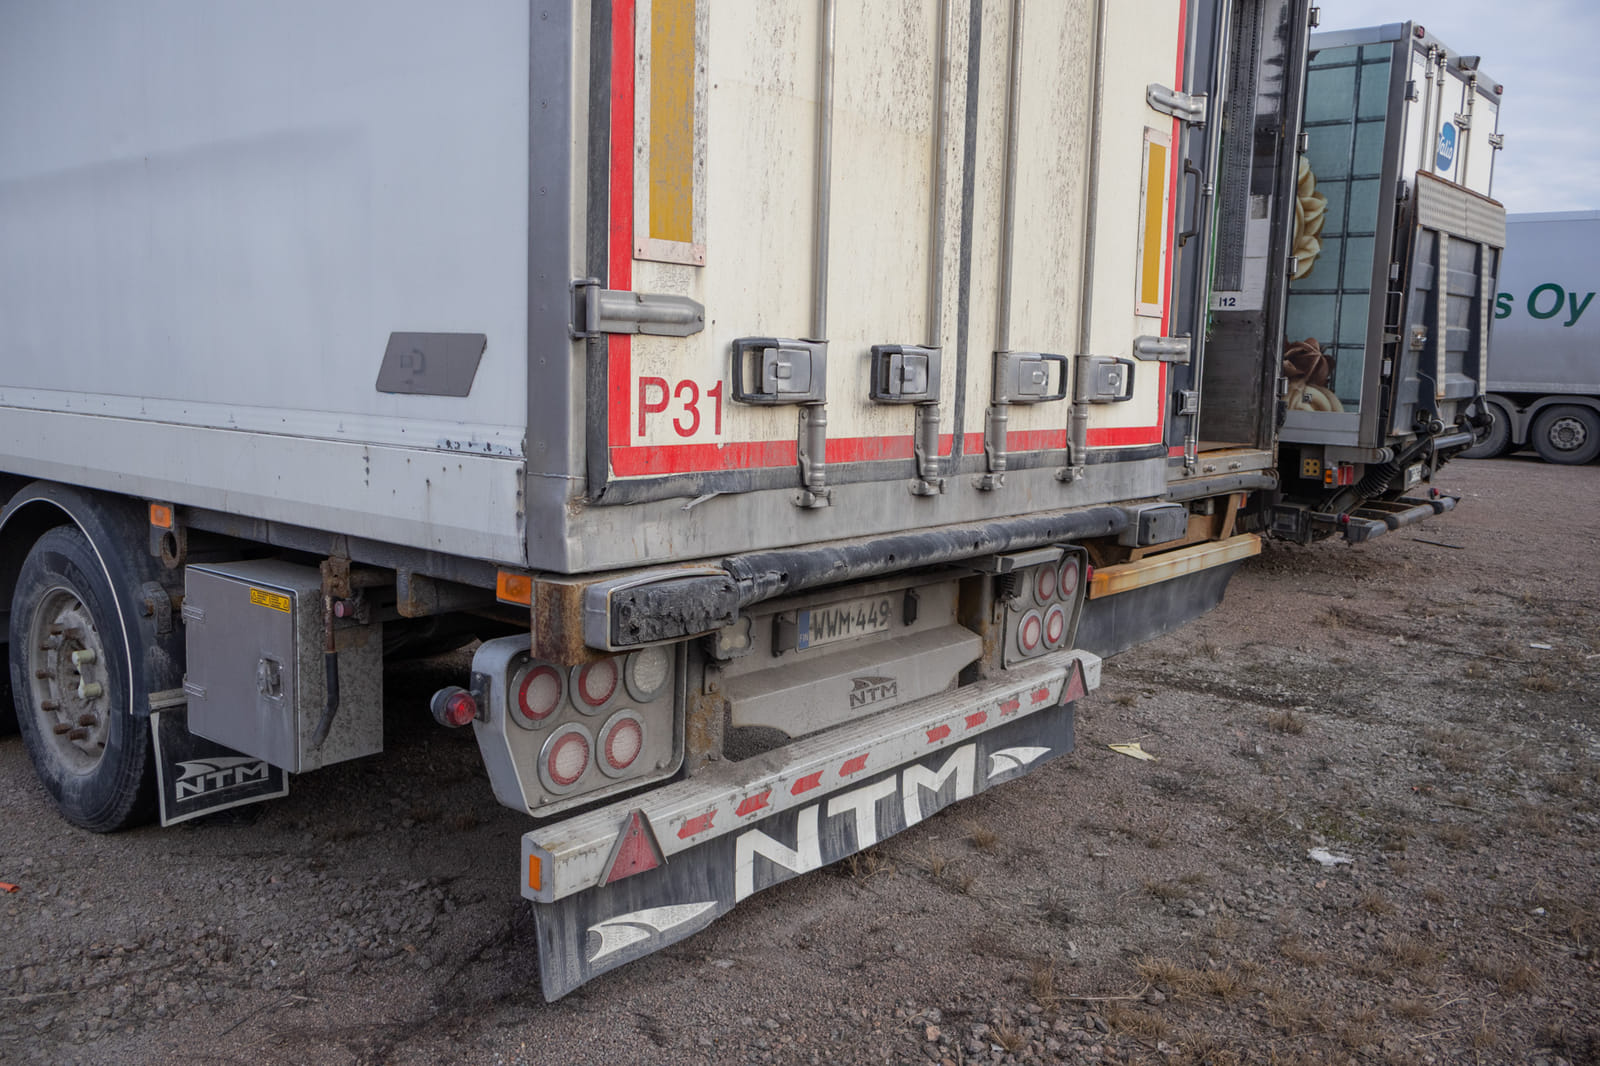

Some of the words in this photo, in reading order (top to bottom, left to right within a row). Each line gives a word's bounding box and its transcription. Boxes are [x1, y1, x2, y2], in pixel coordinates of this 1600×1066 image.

[1527, 283, 1596, 327] Oy
[638, 376, 722, 437] P31
[850, 681, 897, 707] NTM
[176, 761, 269, 799] NTM
[735, 743, 976, 903] NTM
